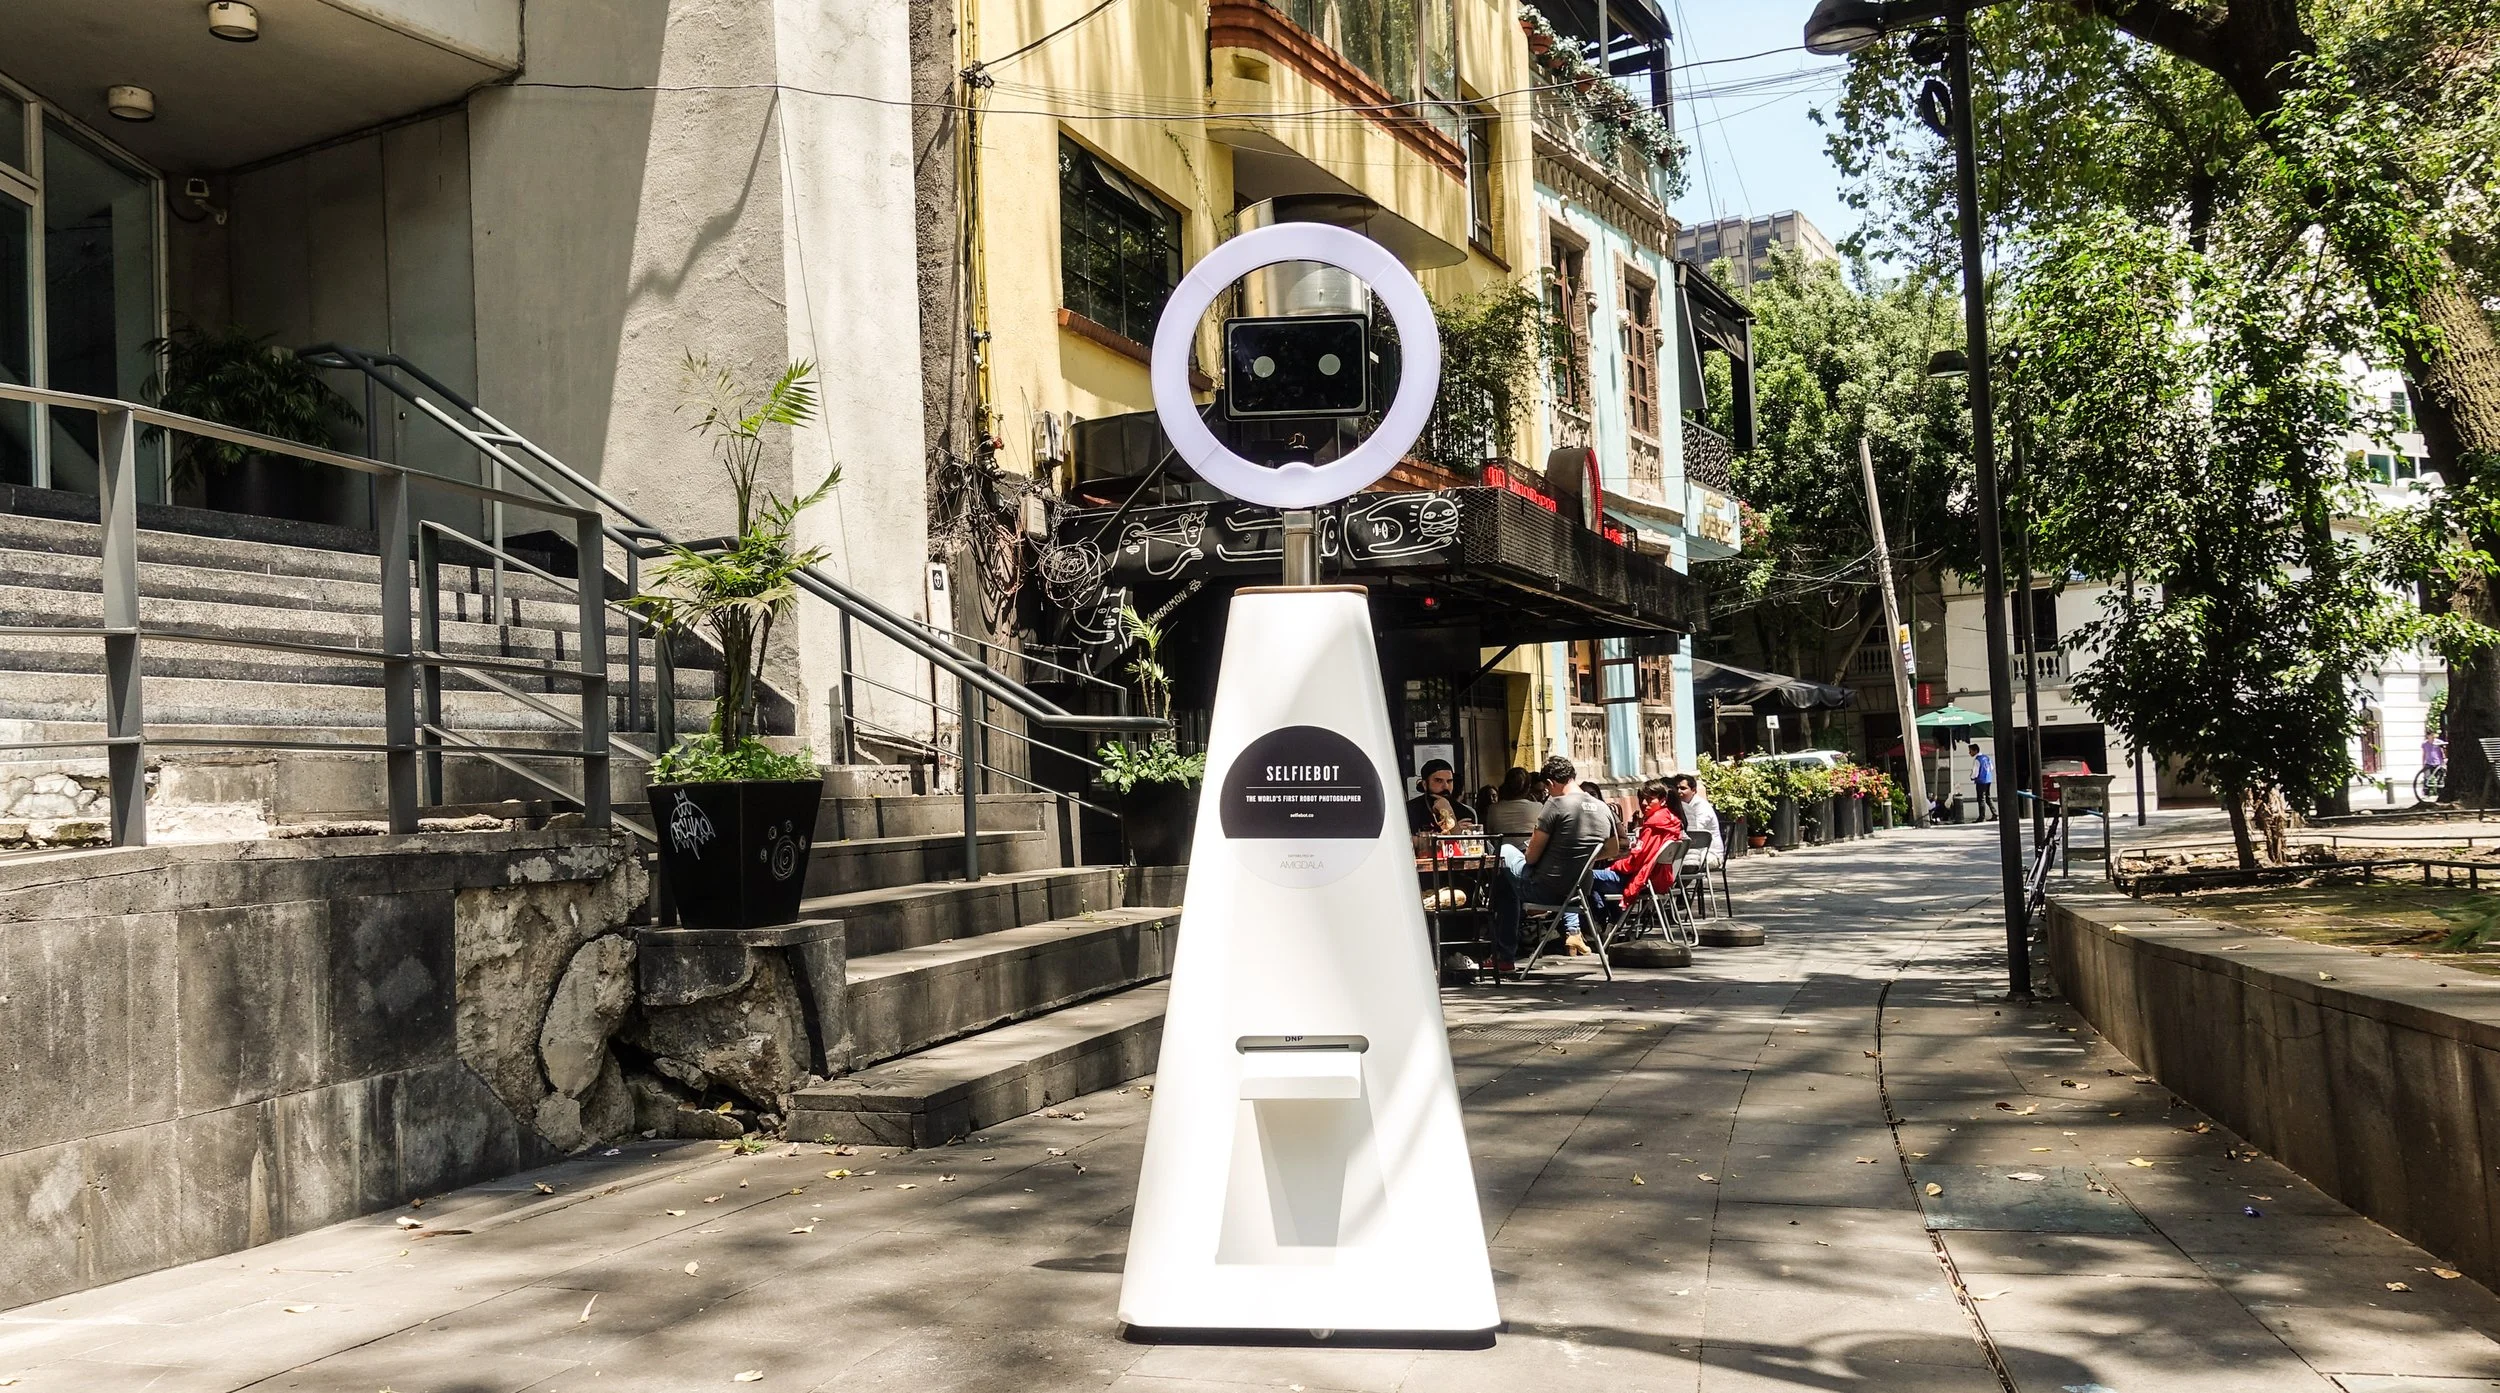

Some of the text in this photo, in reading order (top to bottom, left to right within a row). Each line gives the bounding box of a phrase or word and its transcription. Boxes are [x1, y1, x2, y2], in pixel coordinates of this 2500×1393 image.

[1266, 765, 1340, 782] SELFIEBOT
[1246, 795, 1361, 803] THE WORLD'S FIRST ROBOT PHOTOGRAPHER
